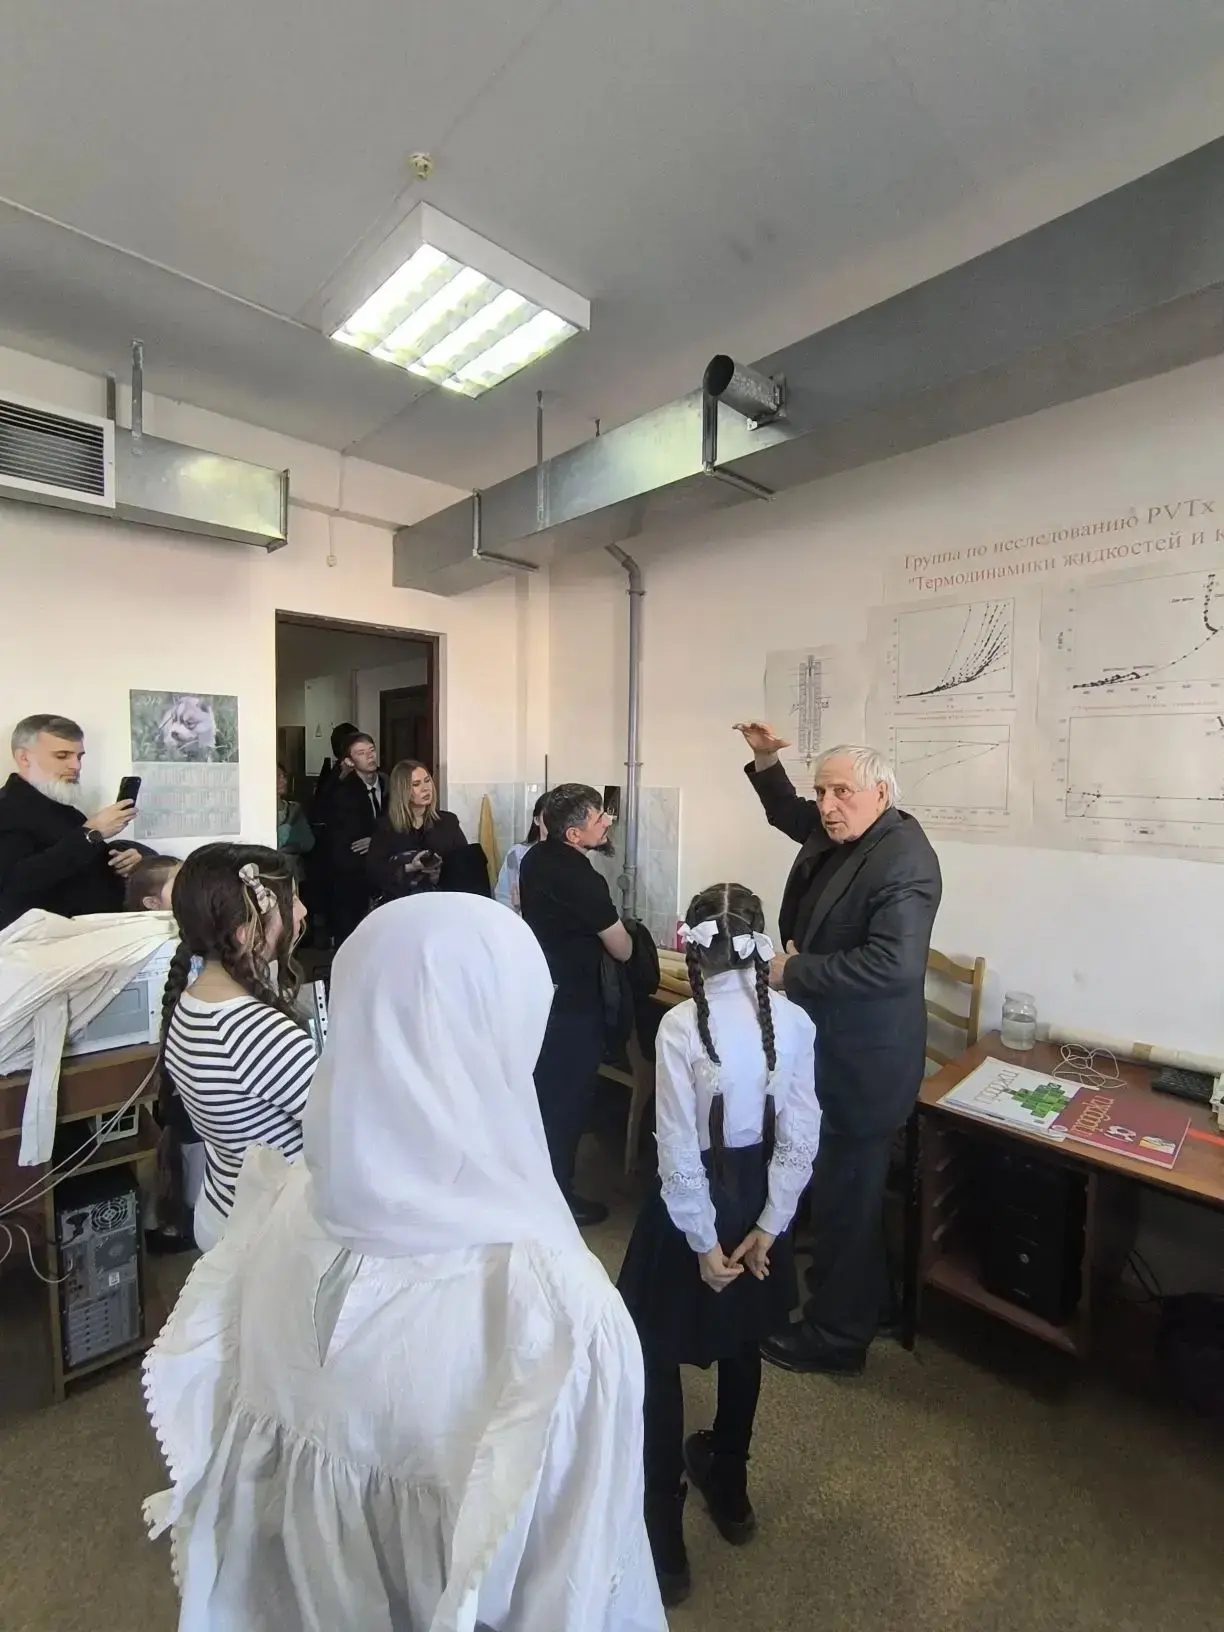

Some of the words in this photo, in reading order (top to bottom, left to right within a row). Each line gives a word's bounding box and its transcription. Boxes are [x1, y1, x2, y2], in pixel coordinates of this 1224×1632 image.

[904, 550, 960, 571] Группа
[967, 545, 988, 559] по
[994, 516, 1139, 553] исследованию
[1148, 498, 1216, 524] PVTx
[908, 558, 1056, 592] "Термодинамики
[1062, 531, 1182, 567] жидкостей
[1191, 531, 1204, 546] и
